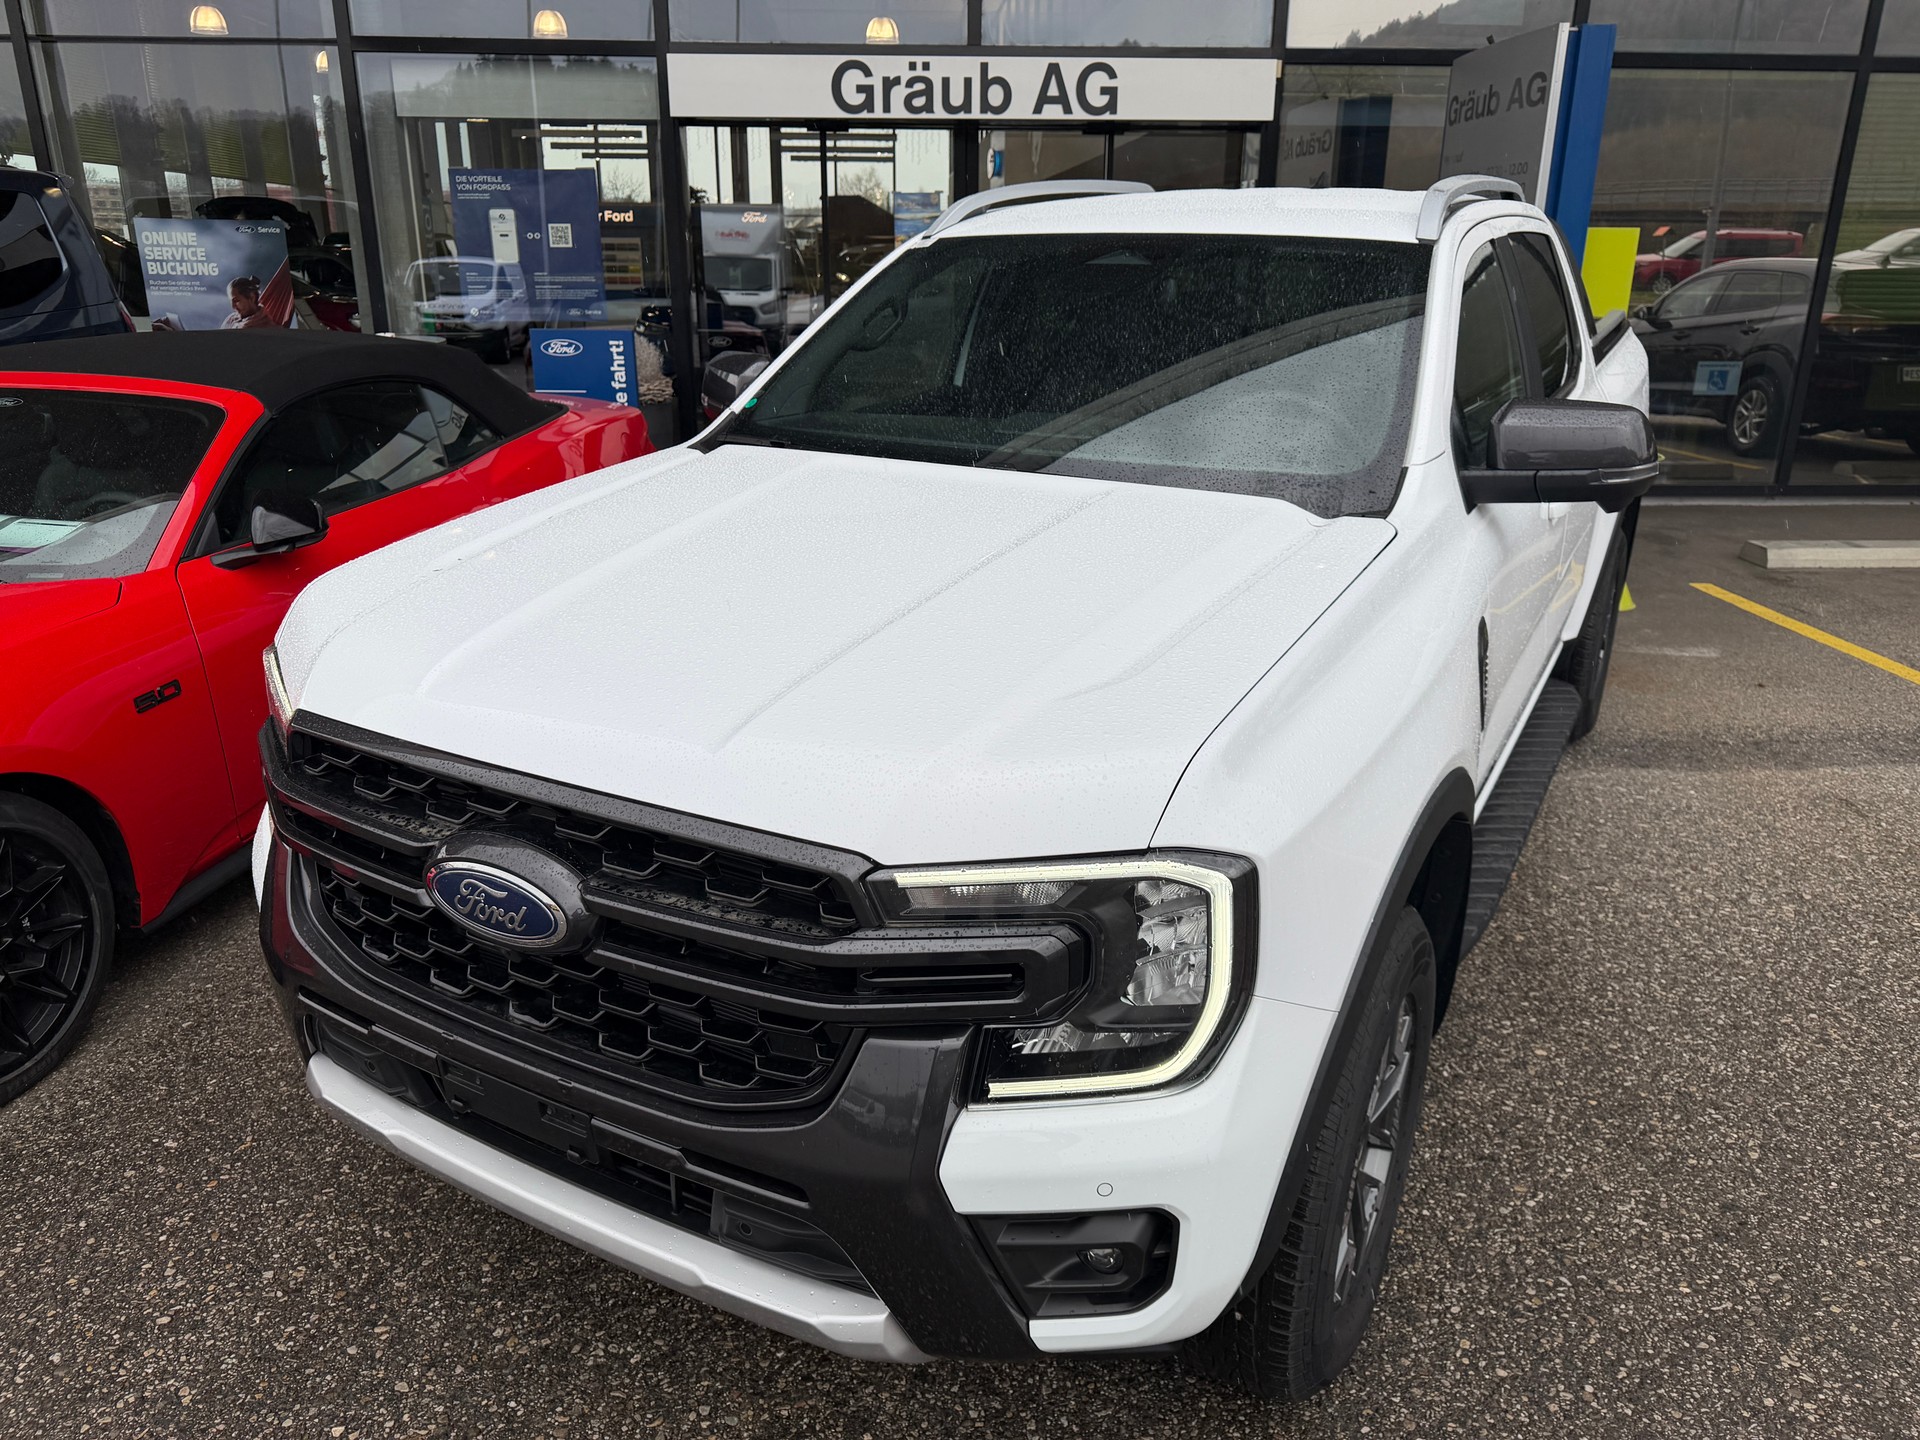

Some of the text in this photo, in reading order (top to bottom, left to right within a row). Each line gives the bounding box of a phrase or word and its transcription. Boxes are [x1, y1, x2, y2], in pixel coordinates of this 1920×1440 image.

[831, 59, 1119, 116] Gräub AG
[1448, 71, 1548, 127] Gräub AG
[455, 175, 503, 183] DIE VORTEILE
[457, 183, 511, 191] VON FORDPASS
[604, 210, 634, 222] Ford
[741, 211, 768, 223] Ford
[257, 226, 281, 234] Service
[141, 231, 197, 246] ONLINE
[144, 247, 207, 261] SERVICE
[147, 261, 219, 276] BUCHUNG
[547, 341, 575, 354] Ford
[609, 340, 627, 390] fahrt!
[133, 678, 182, 714] 5.0
[453, 877, 528, 932] Ford
